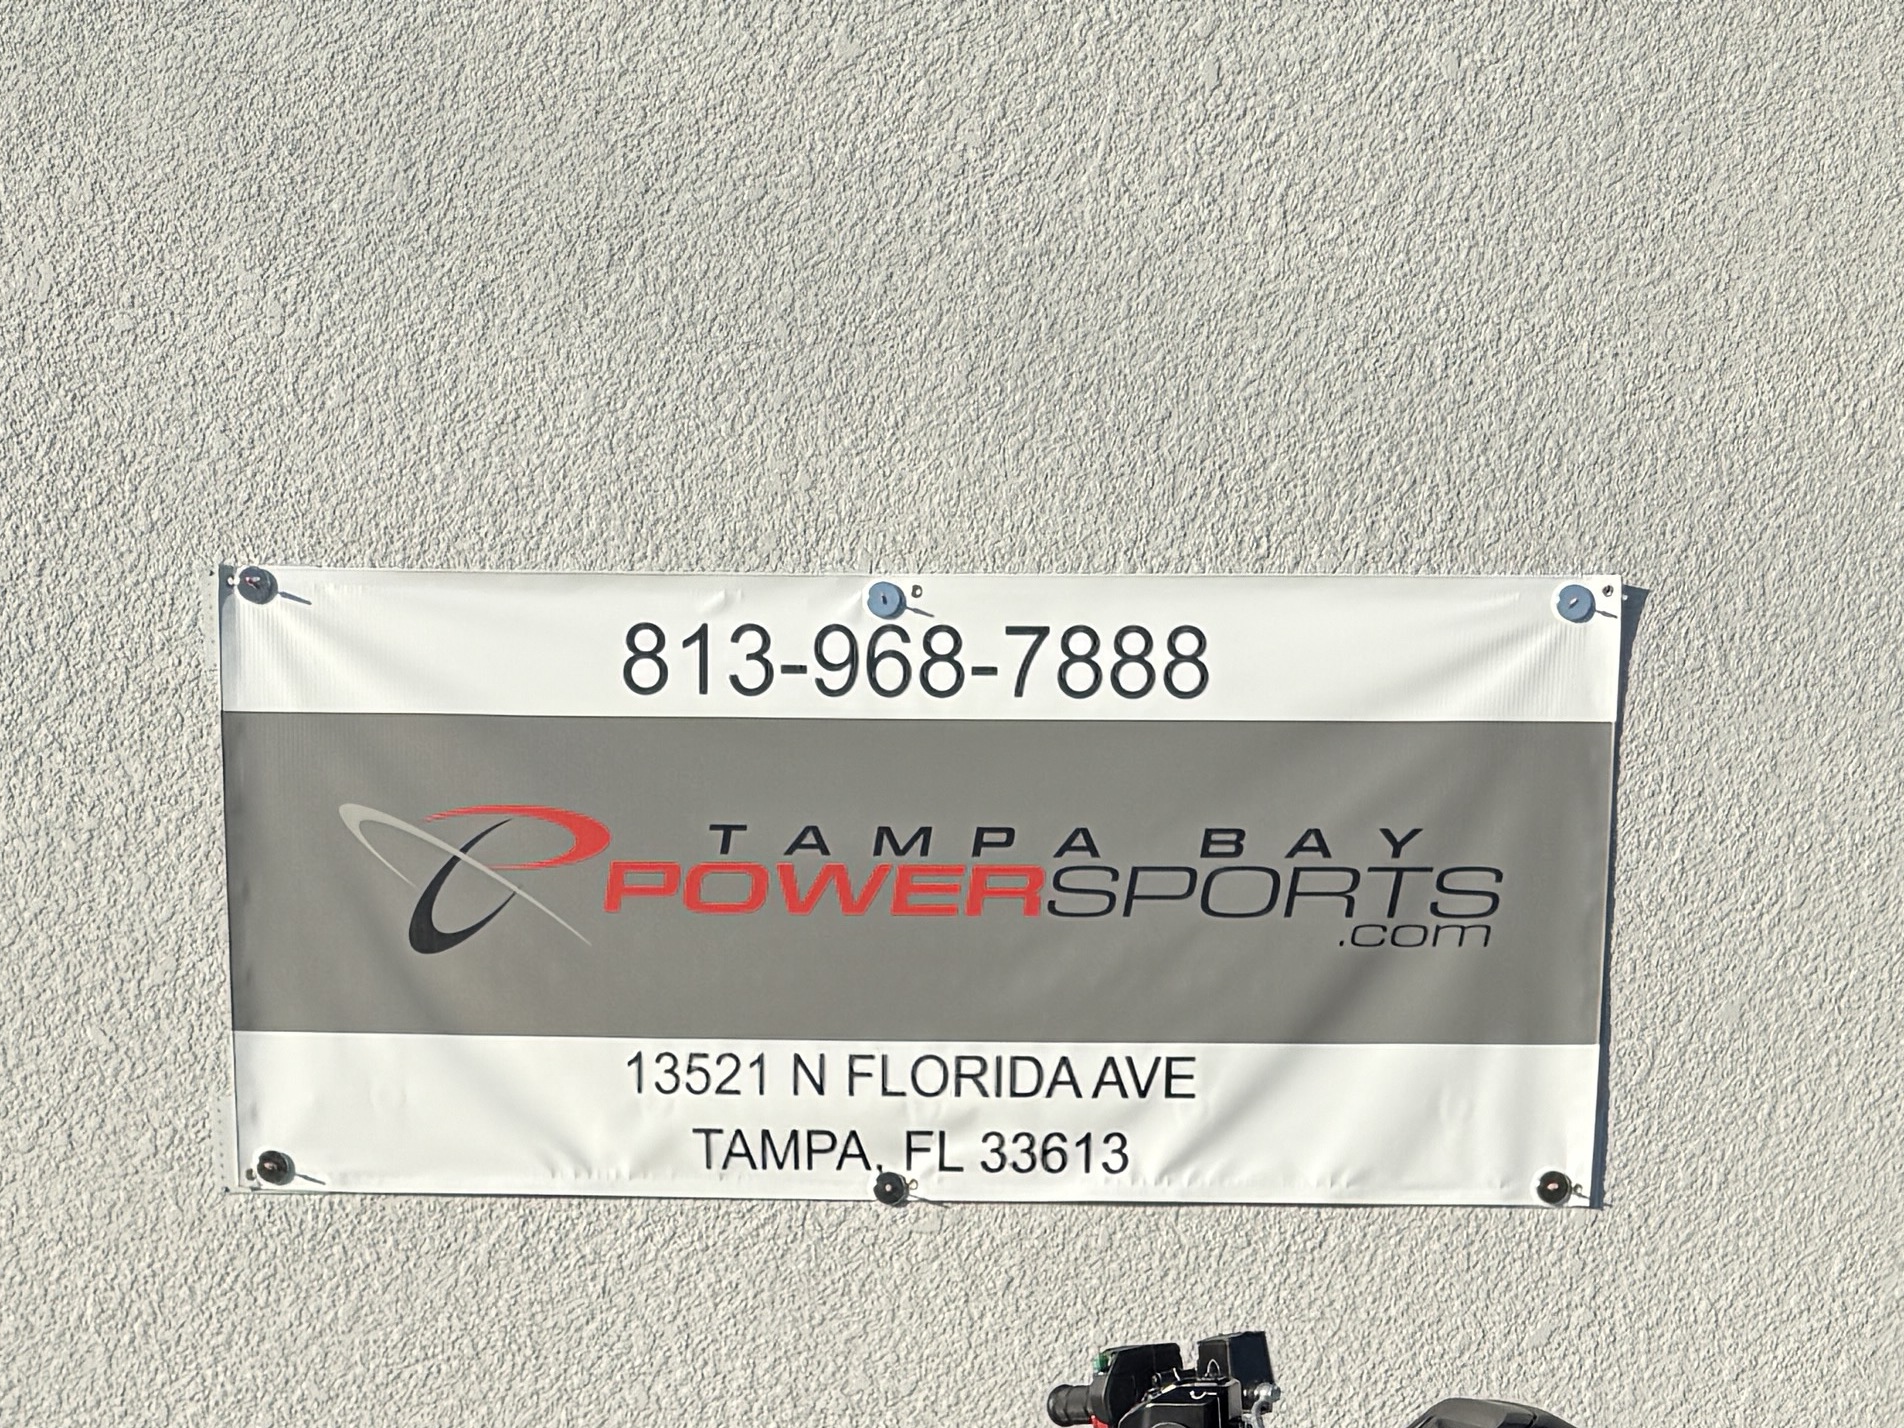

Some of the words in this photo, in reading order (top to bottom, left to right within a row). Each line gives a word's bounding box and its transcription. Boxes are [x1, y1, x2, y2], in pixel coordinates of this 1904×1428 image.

[621, 621, 1210, 699] 813-968-7888
[709, 824, 1101, 858] TAMPA
[1200, 827, 1423, 859] BAY
[603, 860, 1504, 919] POWERSPORTS
[1339, 921, 1492, 948] .com
[626, 1051, 764, 1096] 13521
[793, 1052, 825, 1096] N
[848, 1053, 1084, 1099] FLORIDA
[1091, 1055, 1196, 1100] AVE
[693, 1128, 883, 1180] TAMPA,
[908, 1131, 966, 1173] FL
[980, 1131, 1129, 1175] 33613
